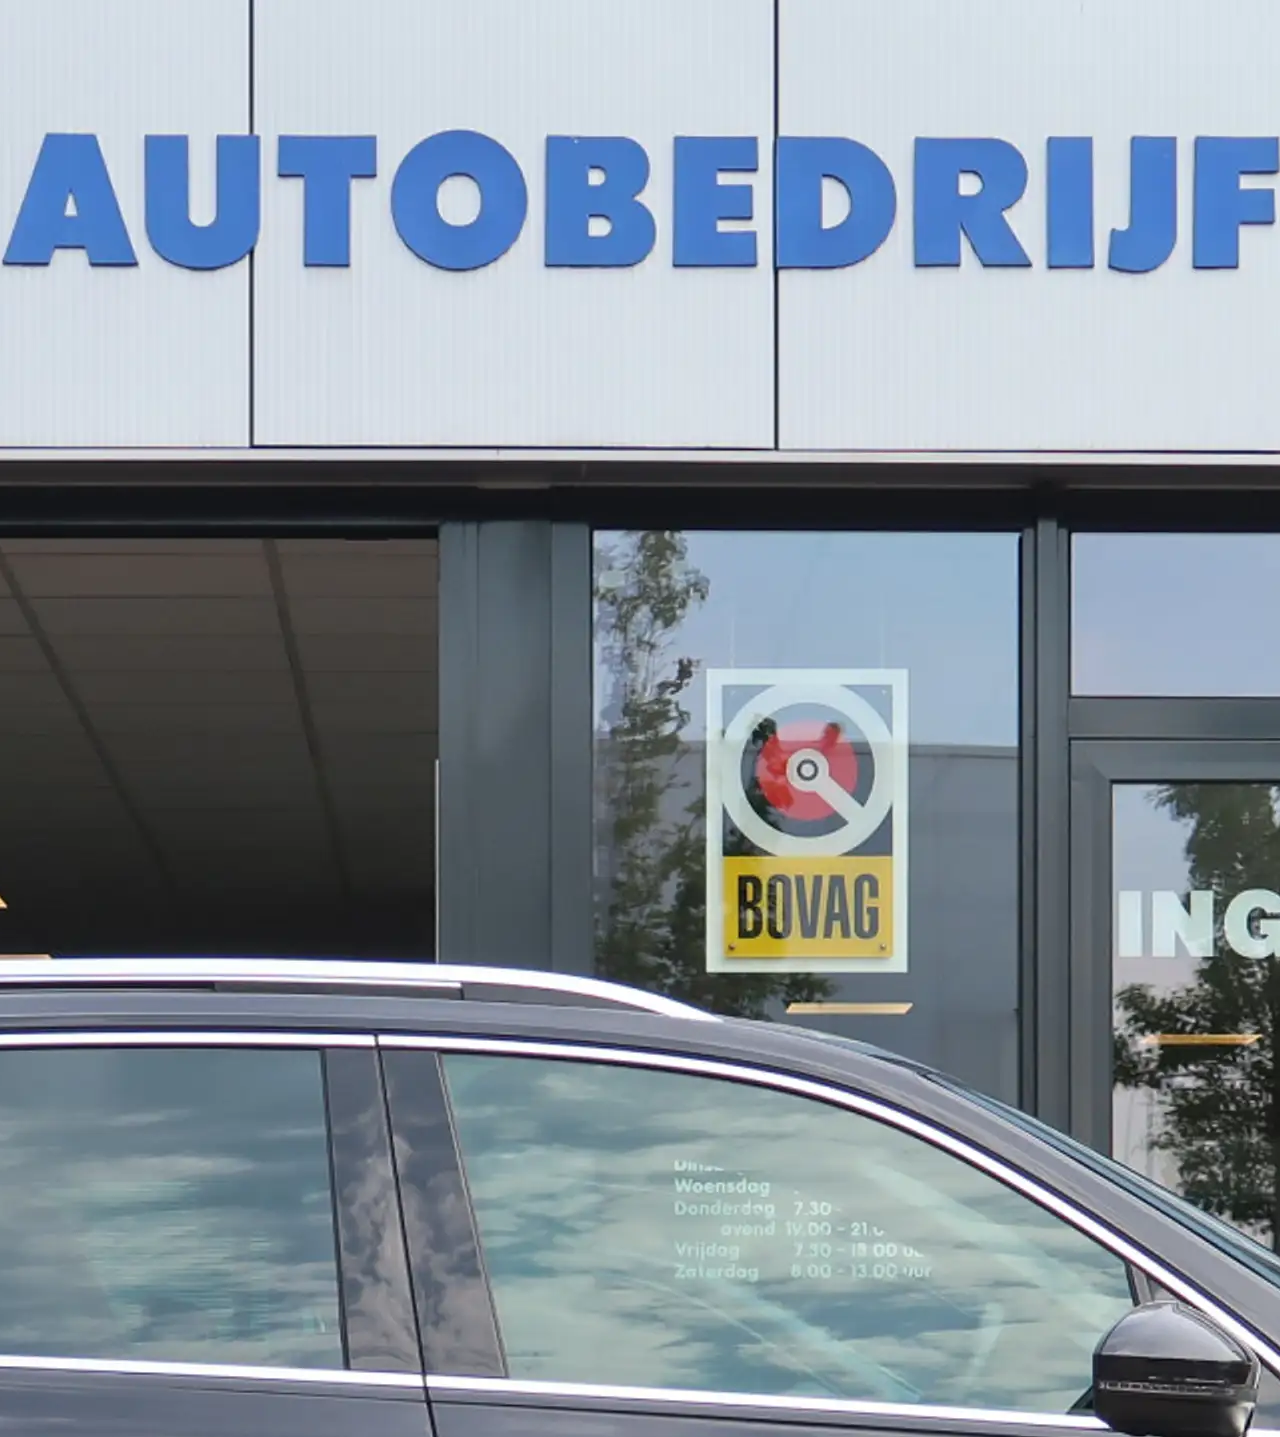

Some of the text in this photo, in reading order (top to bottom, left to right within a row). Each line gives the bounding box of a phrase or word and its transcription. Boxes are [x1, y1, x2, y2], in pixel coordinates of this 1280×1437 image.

[4, 130, 1278, 272] AUTOBEDRIJF
[738, 874, 880, 940] BOVAG
[674, 1178, 771, 1198] Woensdag
[674, 1200, 776, 1220] Donderdag
[721, 1221, 776, 1236] avond
[674, 1241, 740, 1261] Vrijdag
[674, 1263, 759, 1283] Zaterdag
